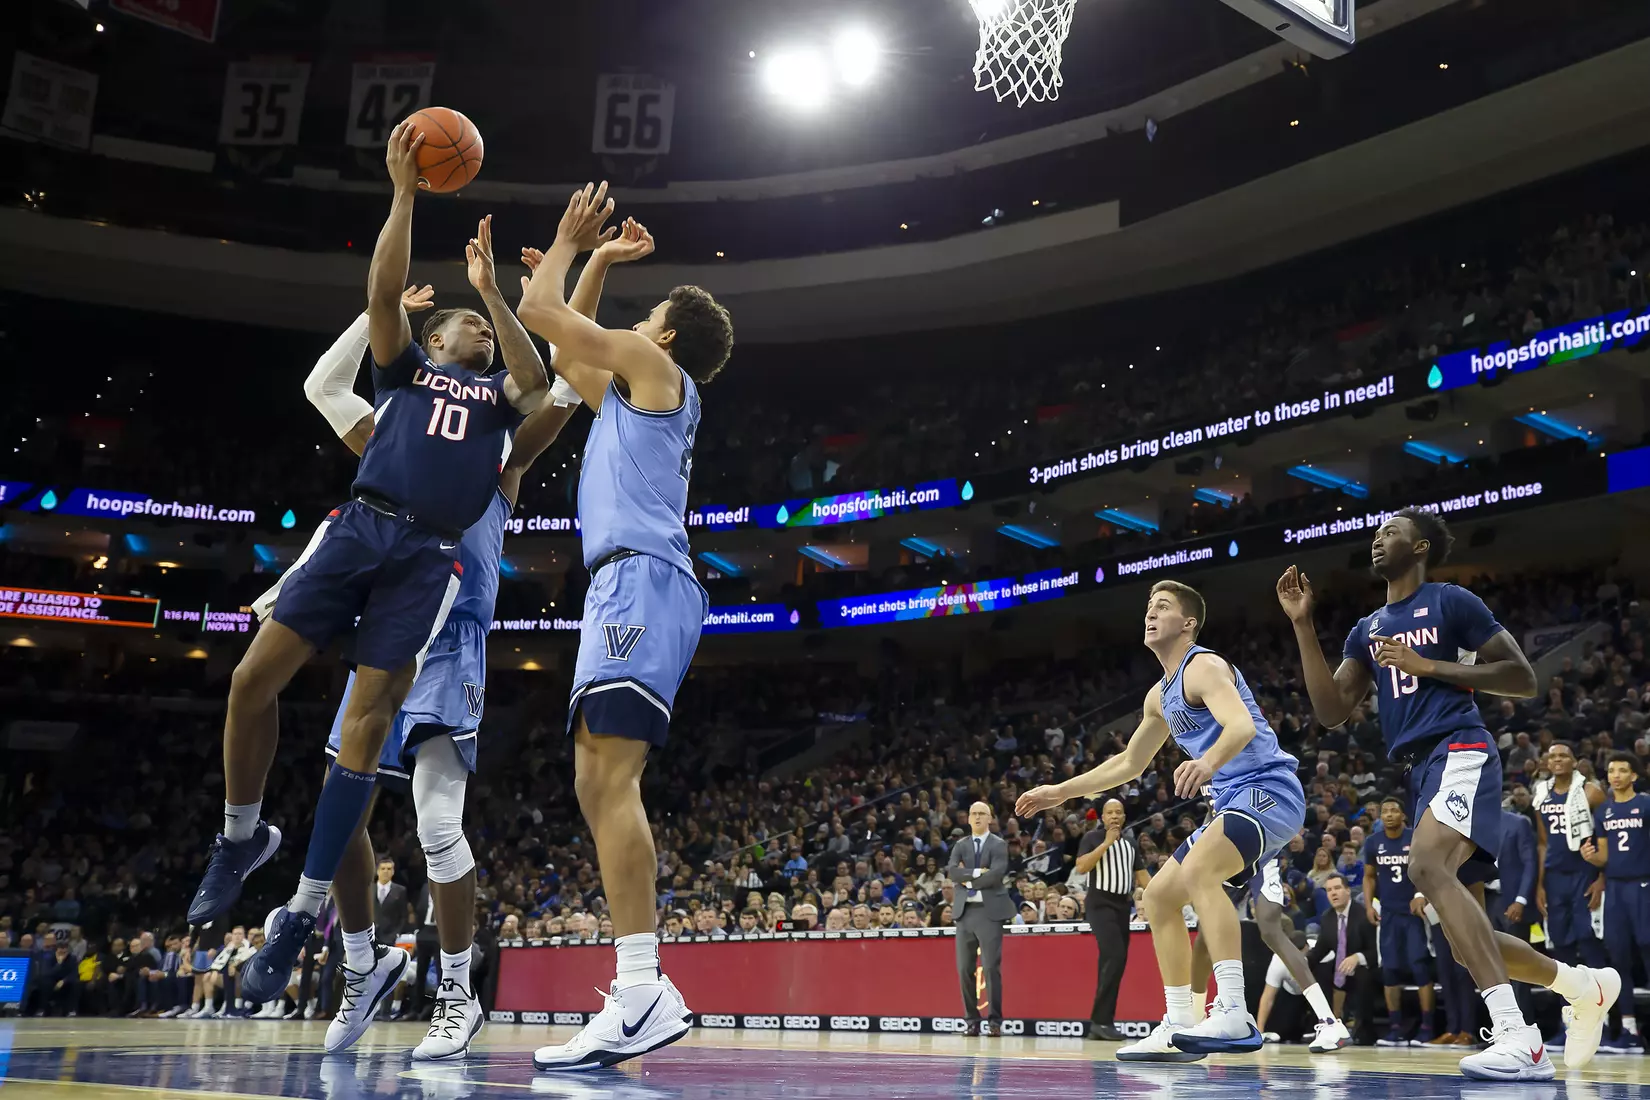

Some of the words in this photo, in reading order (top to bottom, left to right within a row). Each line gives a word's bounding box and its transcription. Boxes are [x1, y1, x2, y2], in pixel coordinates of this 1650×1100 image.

[234, 83, 291, 138] 35
[604, 93, 661, 149] 66
[1471, 314, 1650, 374] hoopsforhaiti.com
[412, 368, 498, 406] UCONN
[427, 397, 469, 441] 10
[1029, 456, 1078, 483] 3-point
[1080, 449, 1118, 471] shots
[1121, 438, 1159, 461] bring
[1162, 427, 1202, 450] clean
[1205, 415, 1251, 439] water
[1254, 410, 1271, 427] to
[1274, 398, 1320, 422] those
[1324, 391, 1340, 410] in
[1344, 375, 1395, 405] need!
[86, 493, 255, 523] hoopsforhaiti.com
[812, 488, 940, 519] hoopsforhaiti.com
[689, 510, 703, 526] in
[706, 507, 749, 525] need!
[1284, 523, 1327, 544] 3-point
[1330, 515, 1364, 535] shots
[1441, 493, 1482, 513] water
[1485, 490, 1499, 505] to
[1502, 482, 1543, 501] those
[527, 515, 571, 530] clean
[1118, 547, 1213, 575] hoopsforhaiti.com
[24, 592, 80, 607] PLEASED
[83, 597, 102, 608] TO
[840, 603, 877, 618] 3-point
[879, 599, 906, 613] shots
[909, 596, 936, 610] bring
[938, 592, 966, 606] clean
[969, 589, 999, 602] water
[1001, 587, 1011, 598] to
[1012, 583, 1038, 596] those
[1040, 579, 1049, 590] in
[1051, 572, 1079, 588] need!
[164, 610, 182, 620] 1:16
[183, 611, 200, 621] PM
[504, 619, 537, 630] water
[540, 618, 552, 630] to
[206, 622, 235, 632] NOVA
[602, 623, 646, 661] V
[1387, 664, 1419, 699] 15
[1248, 787, 1278, 814] V
[1548, 815, 1567, 834] 25
[1603, 818, 1643, 831] UCONN
[1617, 831, 1630, 851] 2
[1376, 855, 1409, 865] UCON
[1391, 865, 1403, 883] 3
[490, 1011, 515, 1023] GEICO
[521, 1012, 549, 1024] GEICO
[554, 1013, 583, 1024] GEICO
[701, 1015, 736, 1027] GEICO
[743, 1016, 780, 1028] GEICO
[783, 1016, 820, 1029] GEICO
[830, 1016, 870, 1030] GEICO
[879, 1017, 921, 1031] GEICO
[932, 1017, 968, 1032] GEIC
[1035, 1021, 1084, 1036] GEICO
